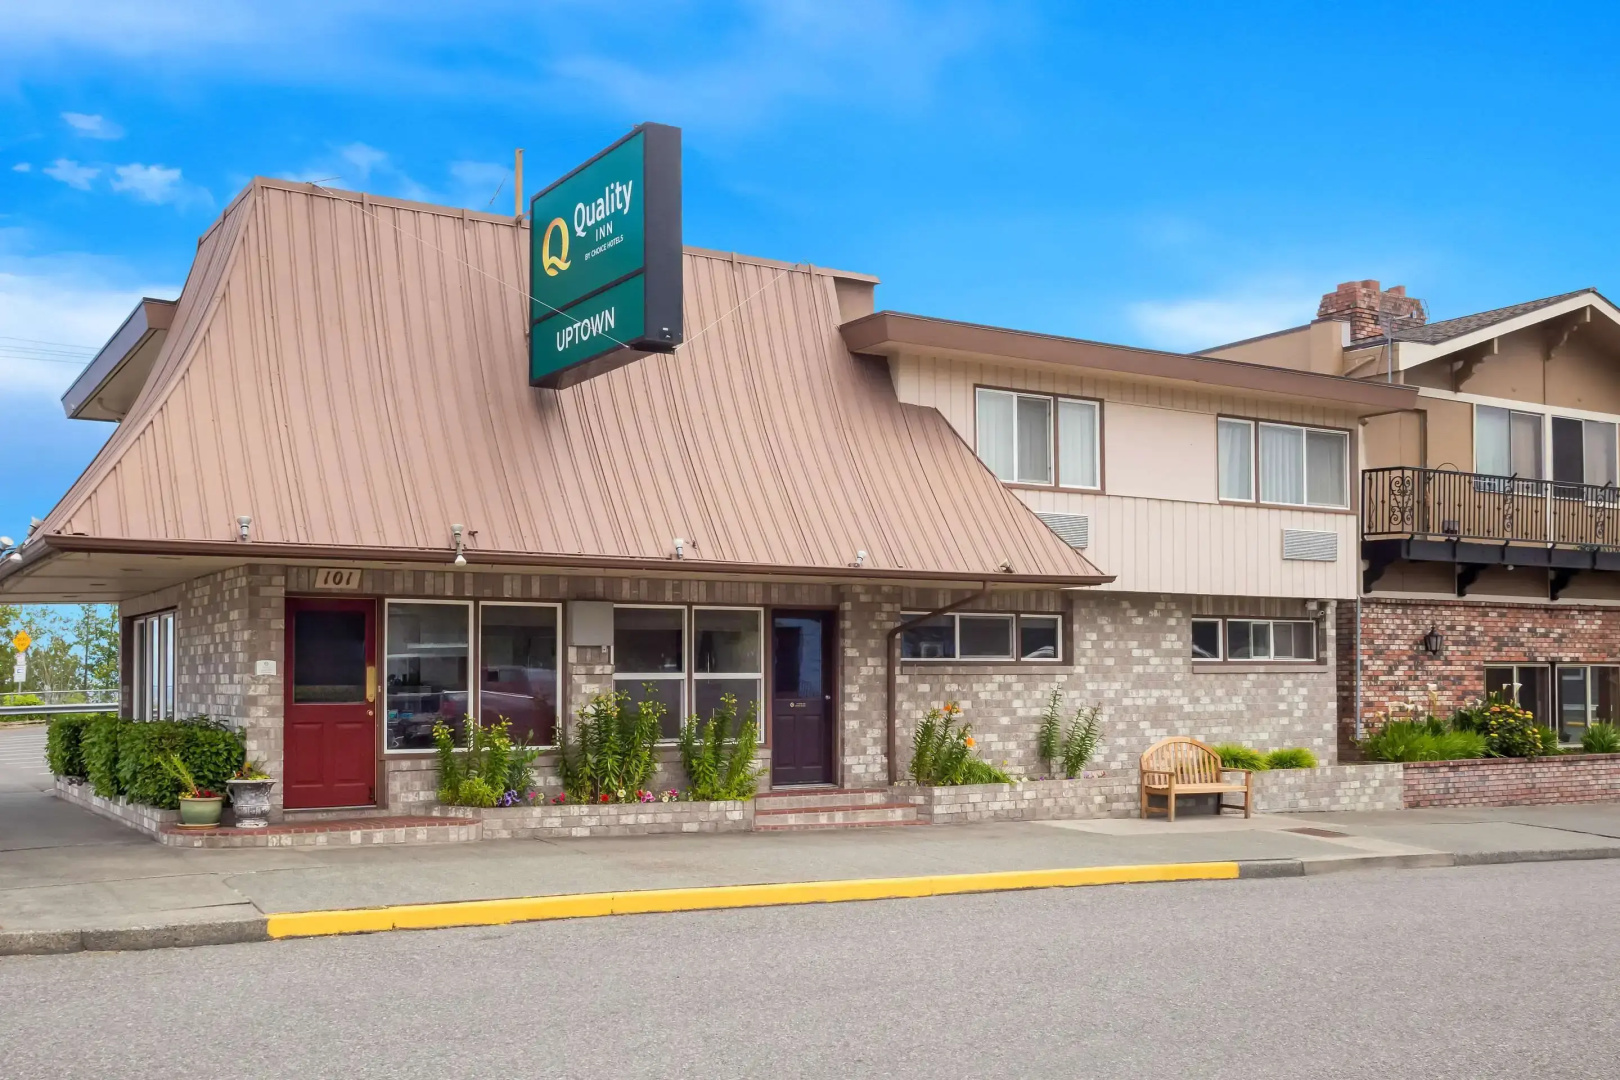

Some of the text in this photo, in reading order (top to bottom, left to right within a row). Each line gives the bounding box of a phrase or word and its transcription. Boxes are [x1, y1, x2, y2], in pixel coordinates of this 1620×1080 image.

[574, 180, 633, 237] Quality
[542, 217, 571, 277] Q
[584, 234, 624, 261] BY CHOICE HOTELS
[595, 220, 613, 242] INN
[556, 306, 615, 352] UPTOWN
[324, 570, 354, 586] 101
